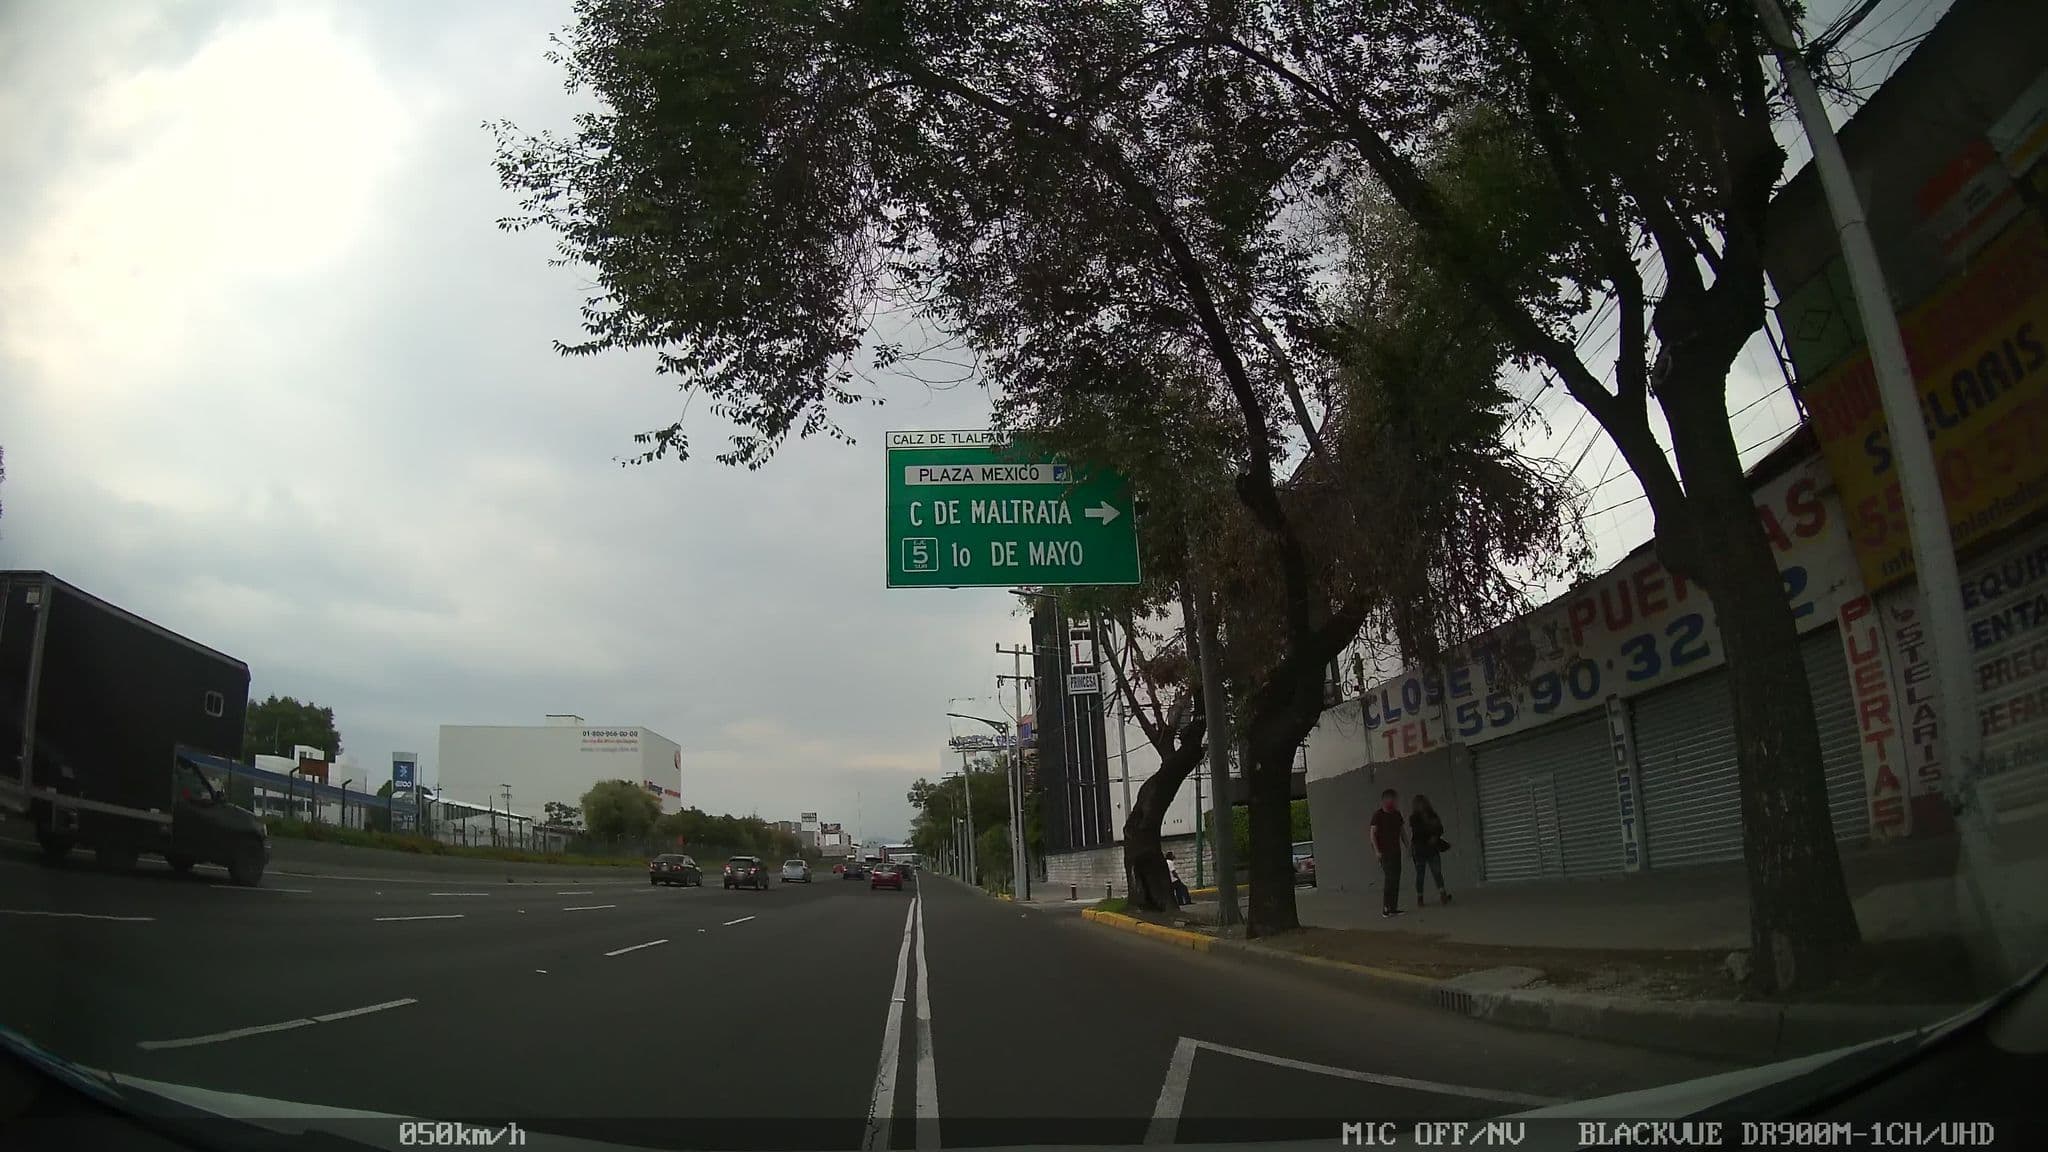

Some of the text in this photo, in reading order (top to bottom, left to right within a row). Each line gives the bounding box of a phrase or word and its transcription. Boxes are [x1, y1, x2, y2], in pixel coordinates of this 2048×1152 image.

[1864, 321, 2046, 475] SLARIS
[893, 434, 925, 445] CALZ
[930, 433, 946, 444] DE
[919, 467, 1039, 482] PLAZA MEXICO
[910, 499, 1072, 526] C DE MALTRATA
[913, 546, 928, 564] 5
[991, 541, 1017, 567] DE
[1029, 541, 1083, 567] MAYO
[1361, 624, 1536, 730] CLOSET
[1839, 594, 1904, 826] PUERTAS
